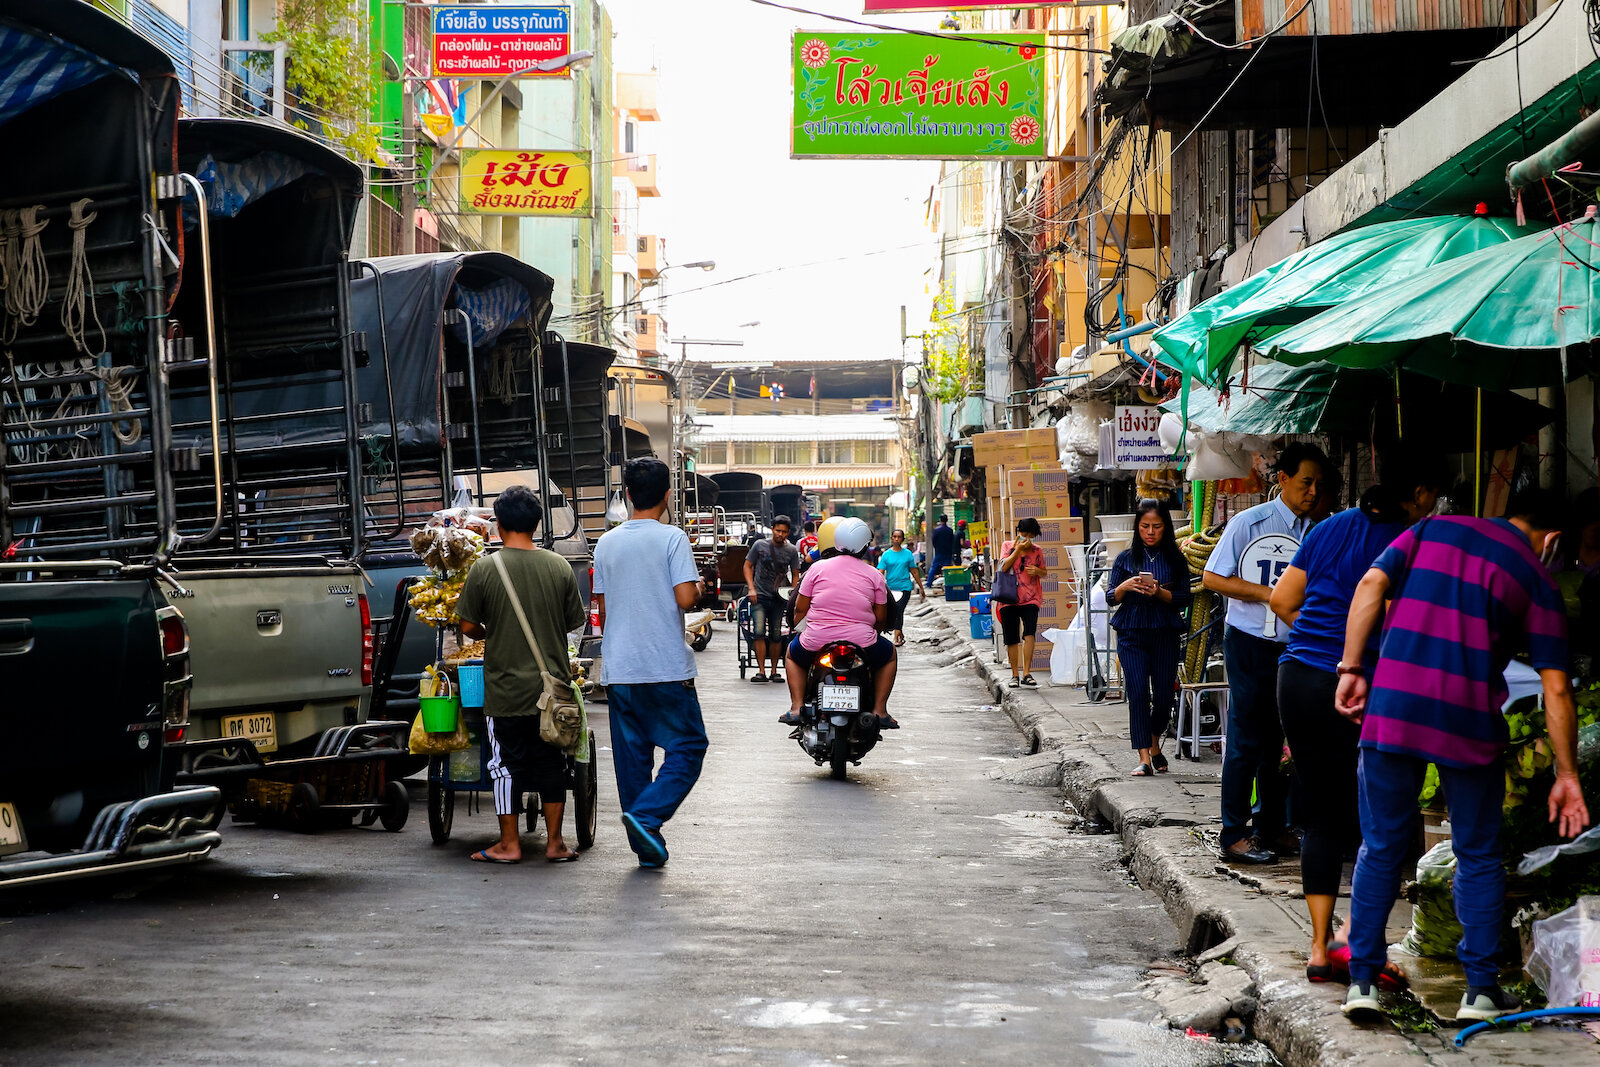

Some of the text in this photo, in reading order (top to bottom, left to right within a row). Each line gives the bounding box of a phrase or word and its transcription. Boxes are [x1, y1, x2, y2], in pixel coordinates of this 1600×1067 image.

[492, 12, 563, 32] บรรจุภัณฑ์
[831, 54, 1010, 107] โล้วเจี้ยเส็ง
[803, 111, 1007, 141] อุปกรณ์ดอกไม้ครบวงจร
[481, 152, 572, 188] เม้ง
[473, 187, 583, 209] สังฆภัณฑ์
[249, 717, 272, 734] 3072
